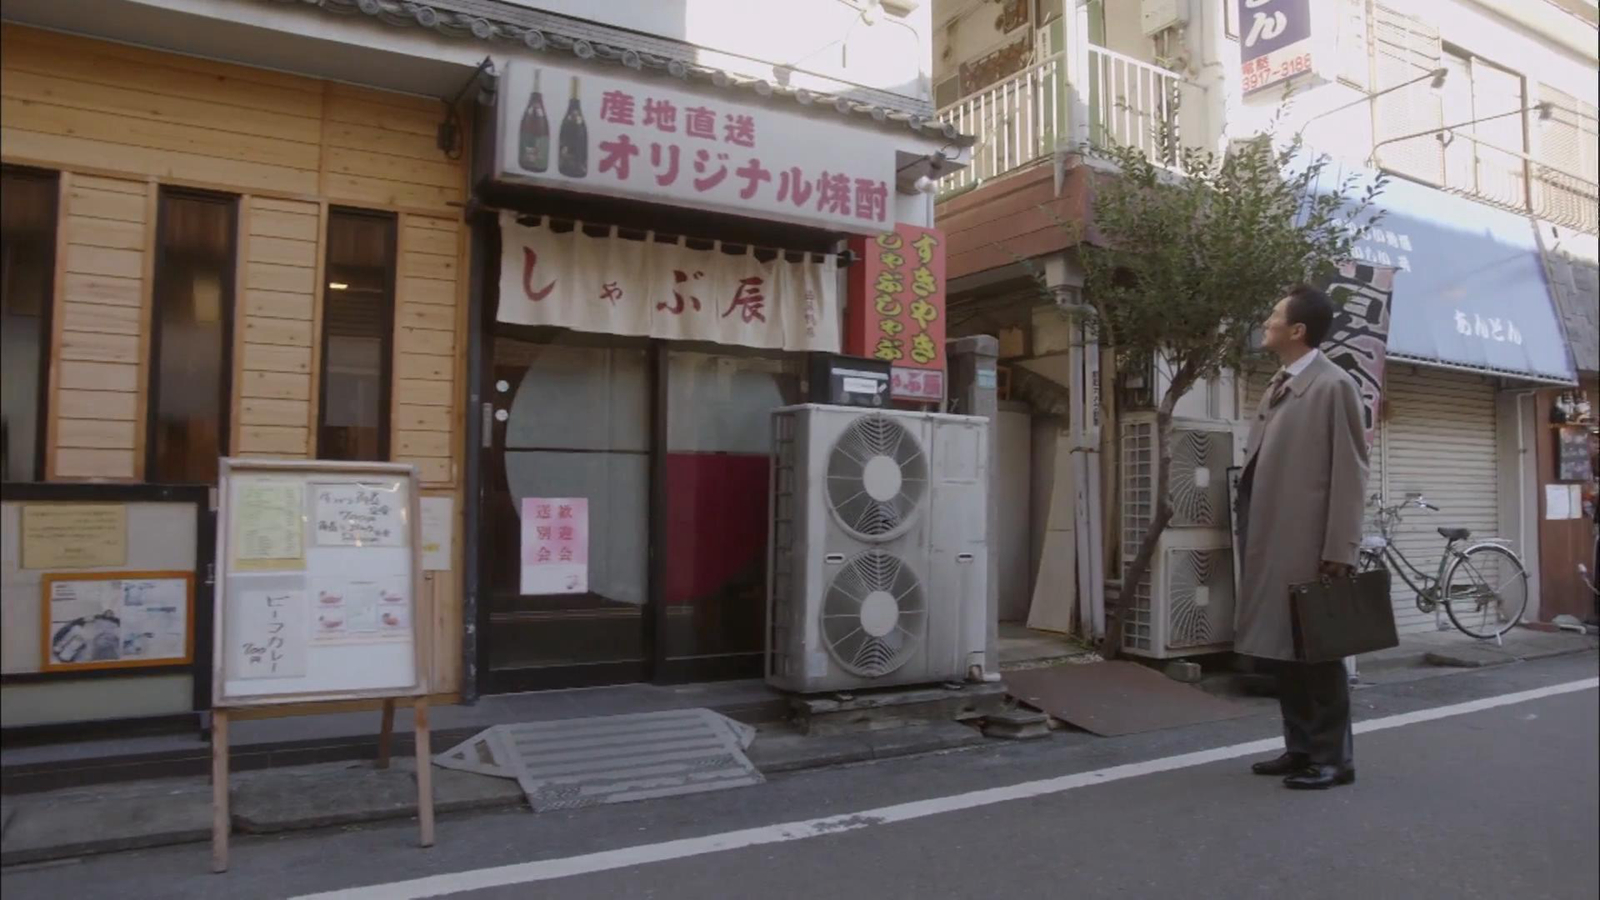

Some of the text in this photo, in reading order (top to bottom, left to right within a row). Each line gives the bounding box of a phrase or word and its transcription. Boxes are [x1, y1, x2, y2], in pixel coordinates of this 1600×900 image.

[600, 90, 756, 148] 産地直送
[598, 134, 889, 223] オリジナル焼酎
[521, 246, 767, 324] しゃぶ辰
[874, 232, 906, 361] しゃぶしゃぶ
[910, 232, 939, 364] すきやき
[1453, 309, 1523, 346] あんどん
[536, 504, 552, 562] 送別会
[558, 504, 574, 562] 歓迎会
[266, 595, 291, 674] ビーフカレー
